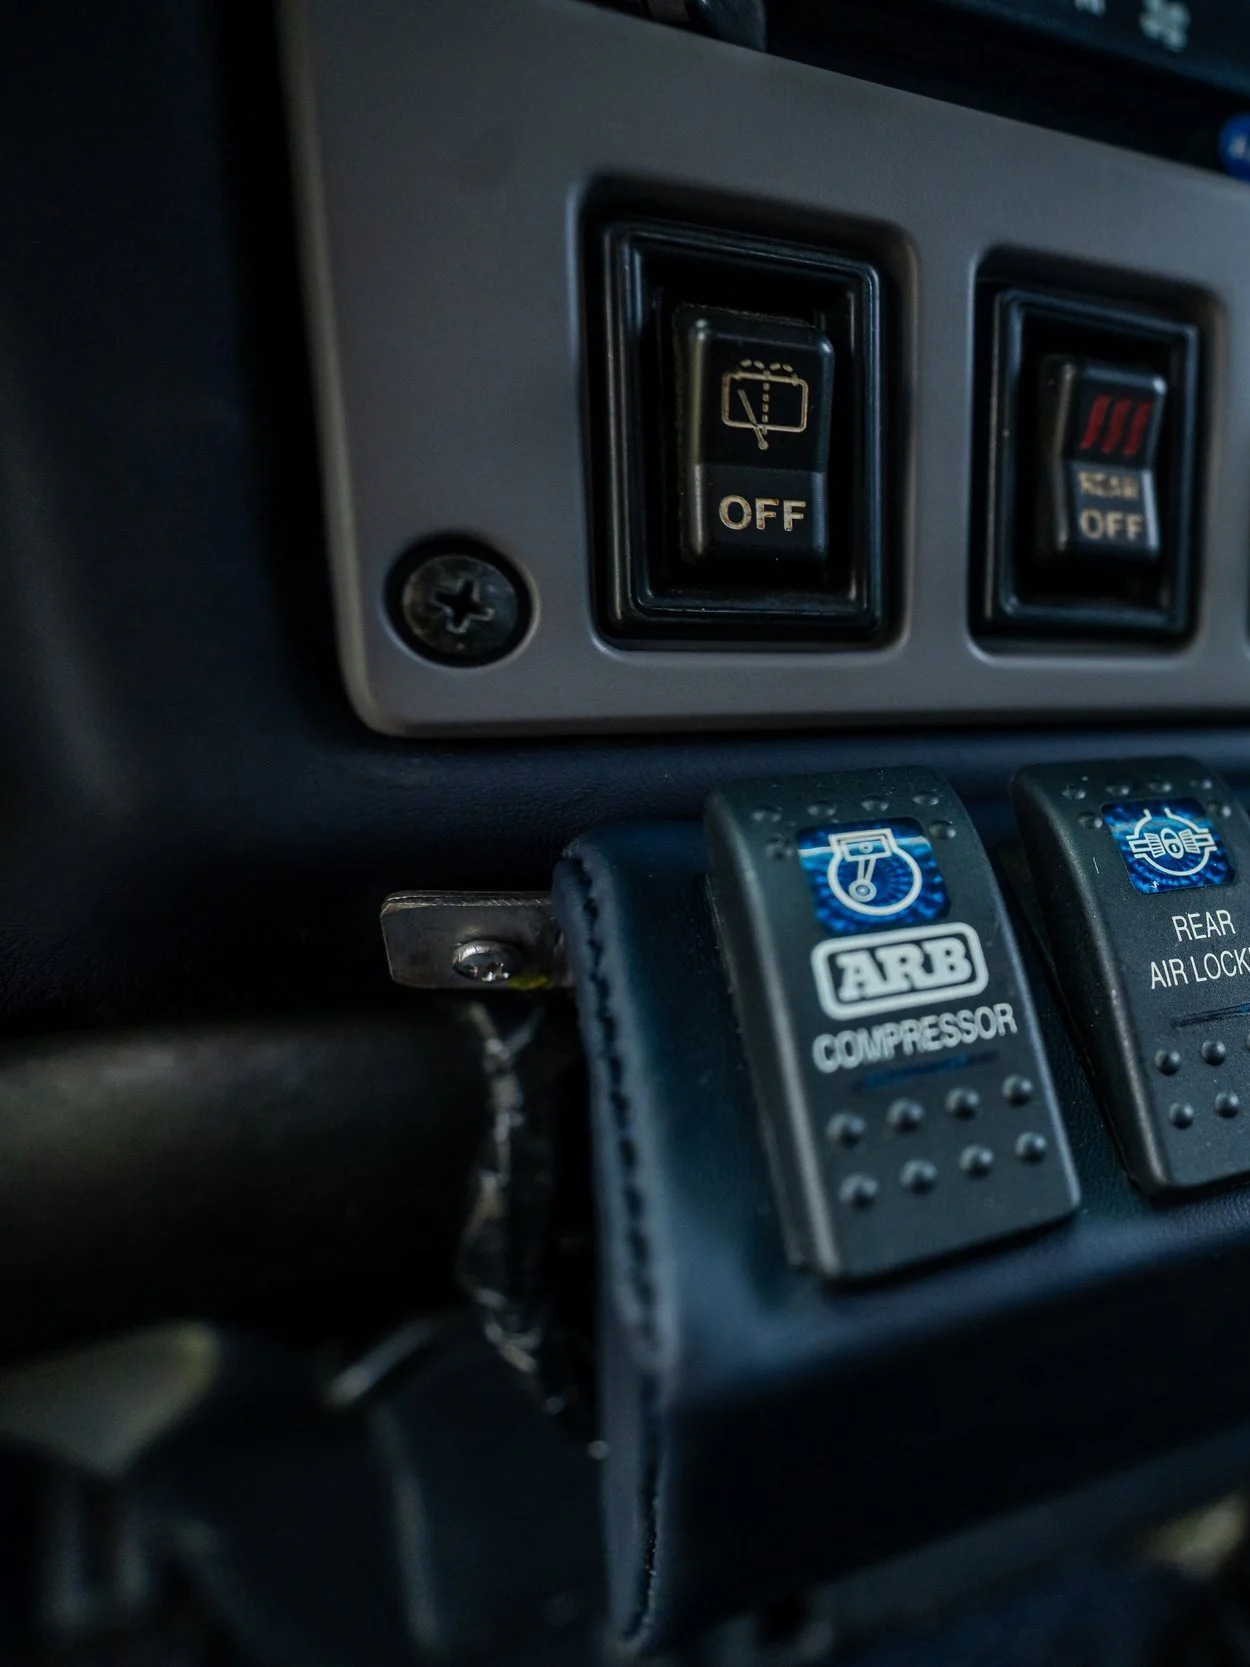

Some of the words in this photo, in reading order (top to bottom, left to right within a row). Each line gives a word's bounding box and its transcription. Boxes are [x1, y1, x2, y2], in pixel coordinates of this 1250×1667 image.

[719, 494, 807, 532] OFF
[1078, 508, 1144, 541] OFF
[1171, 909, 1236, 942] REAR
[836, 937, 973, 1002] ARB
[1150, 958, 1189, 990] AIR
[812, 1002, 1018, 1074] COMPRESSOR
